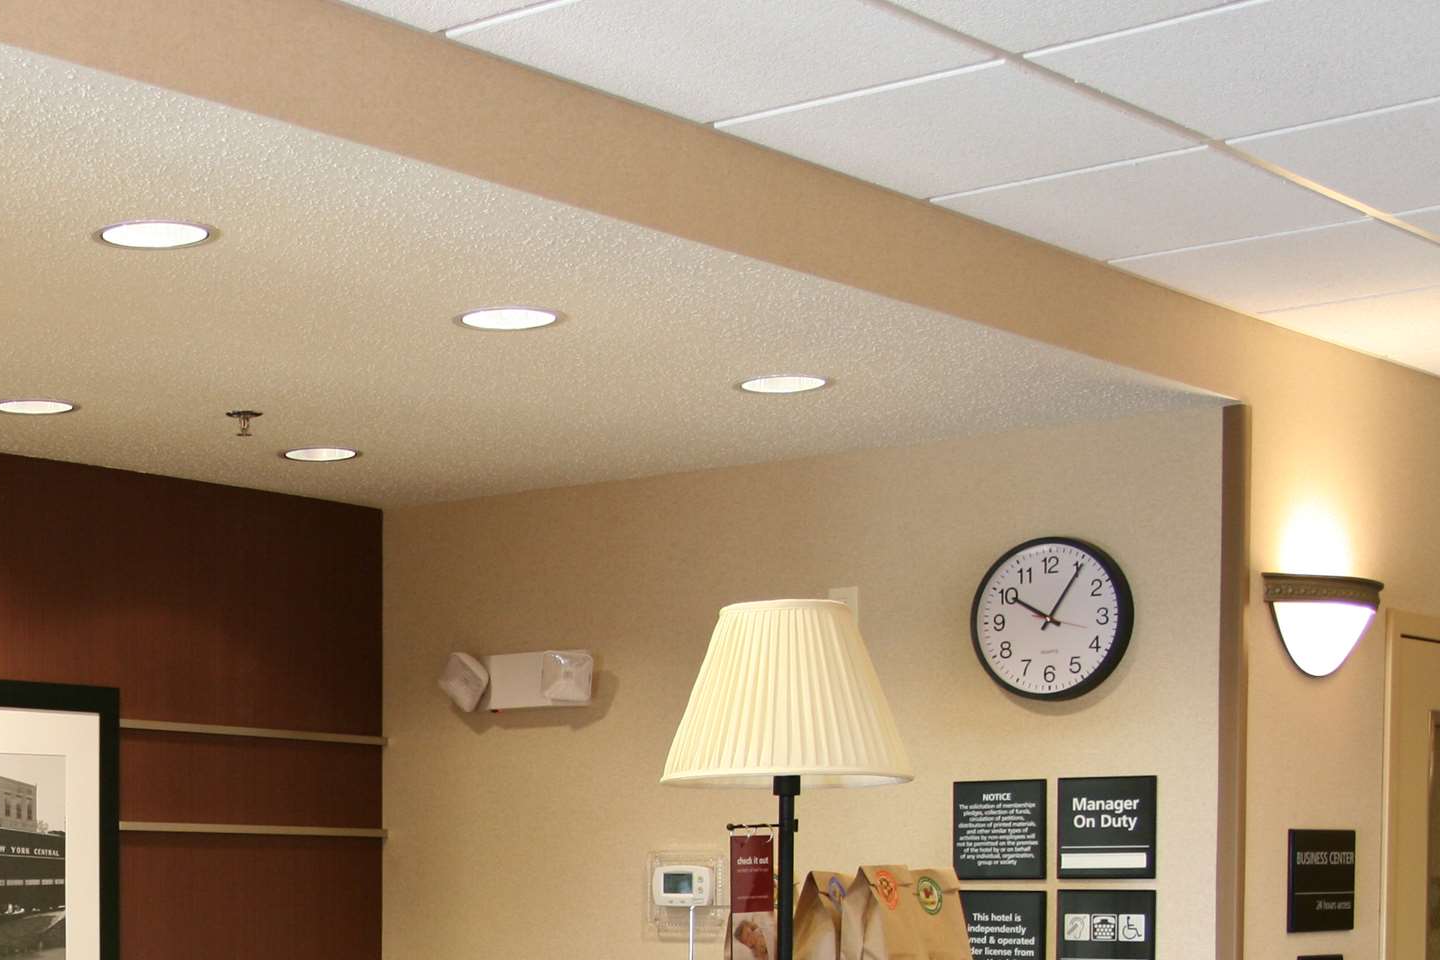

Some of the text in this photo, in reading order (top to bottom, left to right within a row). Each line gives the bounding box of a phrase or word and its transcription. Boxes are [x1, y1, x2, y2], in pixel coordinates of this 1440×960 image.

[1042, 556, 1059, 574] 12
[1017, 567, 1033, 584] 11
[998, 587, 1018, 605] 10
[1090, 579, 1103, 597] 2
[993, 614, 1005, 631] 9
[1096, 607, 1109, 625] 3
[1000, 641, 1012, 659] 8
[1089, 635, 1101, 652] 4
[1021, 659, 1032, 676] 7
[1069, 656, 1081, 673] 5
[1043, 665, 1056, 683] 6
[982, 792, 1012, 801] NOTICE
[1072, 797, 1140, 814] Manager
[1073, 814, 1138, 831] On Duty
[11, 846, 30, 855] YORK
[34, 847, 60, 857] CENTRAL
[1296, 851, 1354, 865] BUSINESS CENTER
[736, 856, 753, 865] check
[972, 912, 1022, 922] This hotel is
[967, 923, 1027, 935] independently
[988, 936, 996, 944] &
[997, 936, 1036, 946] operated
[984, 947, 1012, 956] license
[1014, 947, 1035, 957] from
